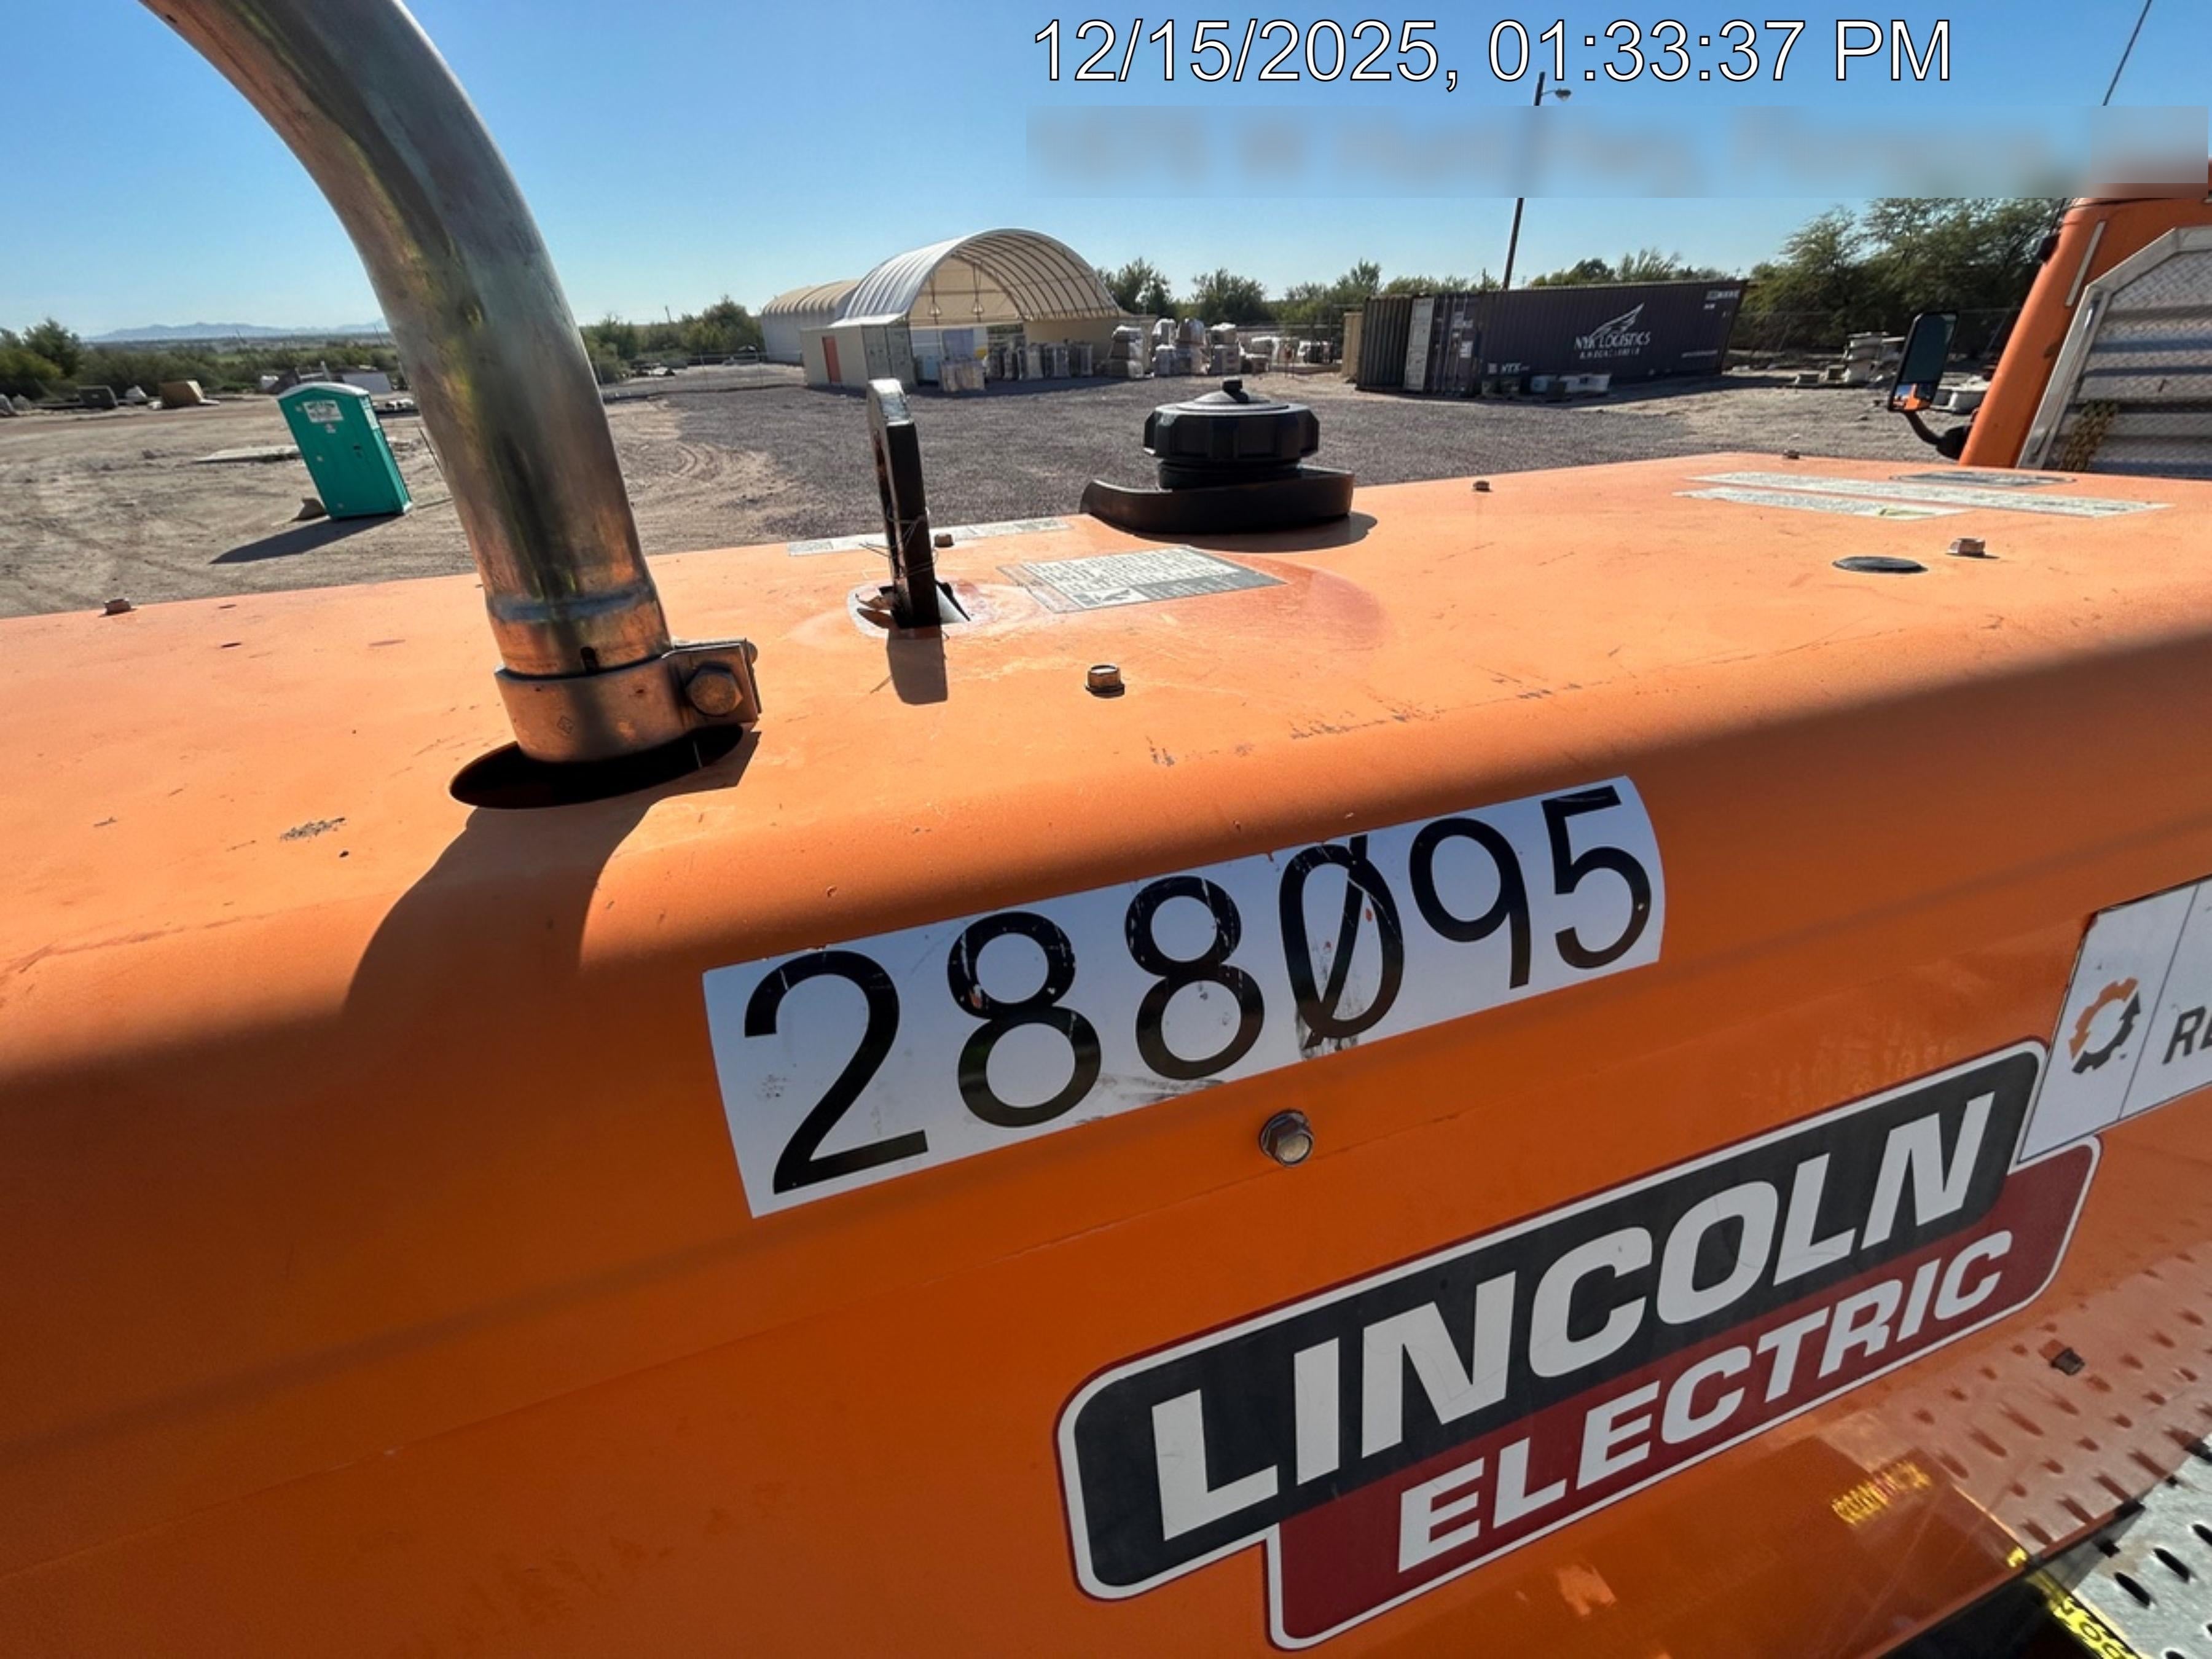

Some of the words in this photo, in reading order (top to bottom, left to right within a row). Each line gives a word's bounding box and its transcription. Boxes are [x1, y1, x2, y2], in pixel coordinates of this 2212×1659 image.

[743, 785, 1652, 1194] 288095
[1152, 1092, 1994, 1540] LINCOLN
[1397, 1231, 2012, 1572] ELECTRIC
